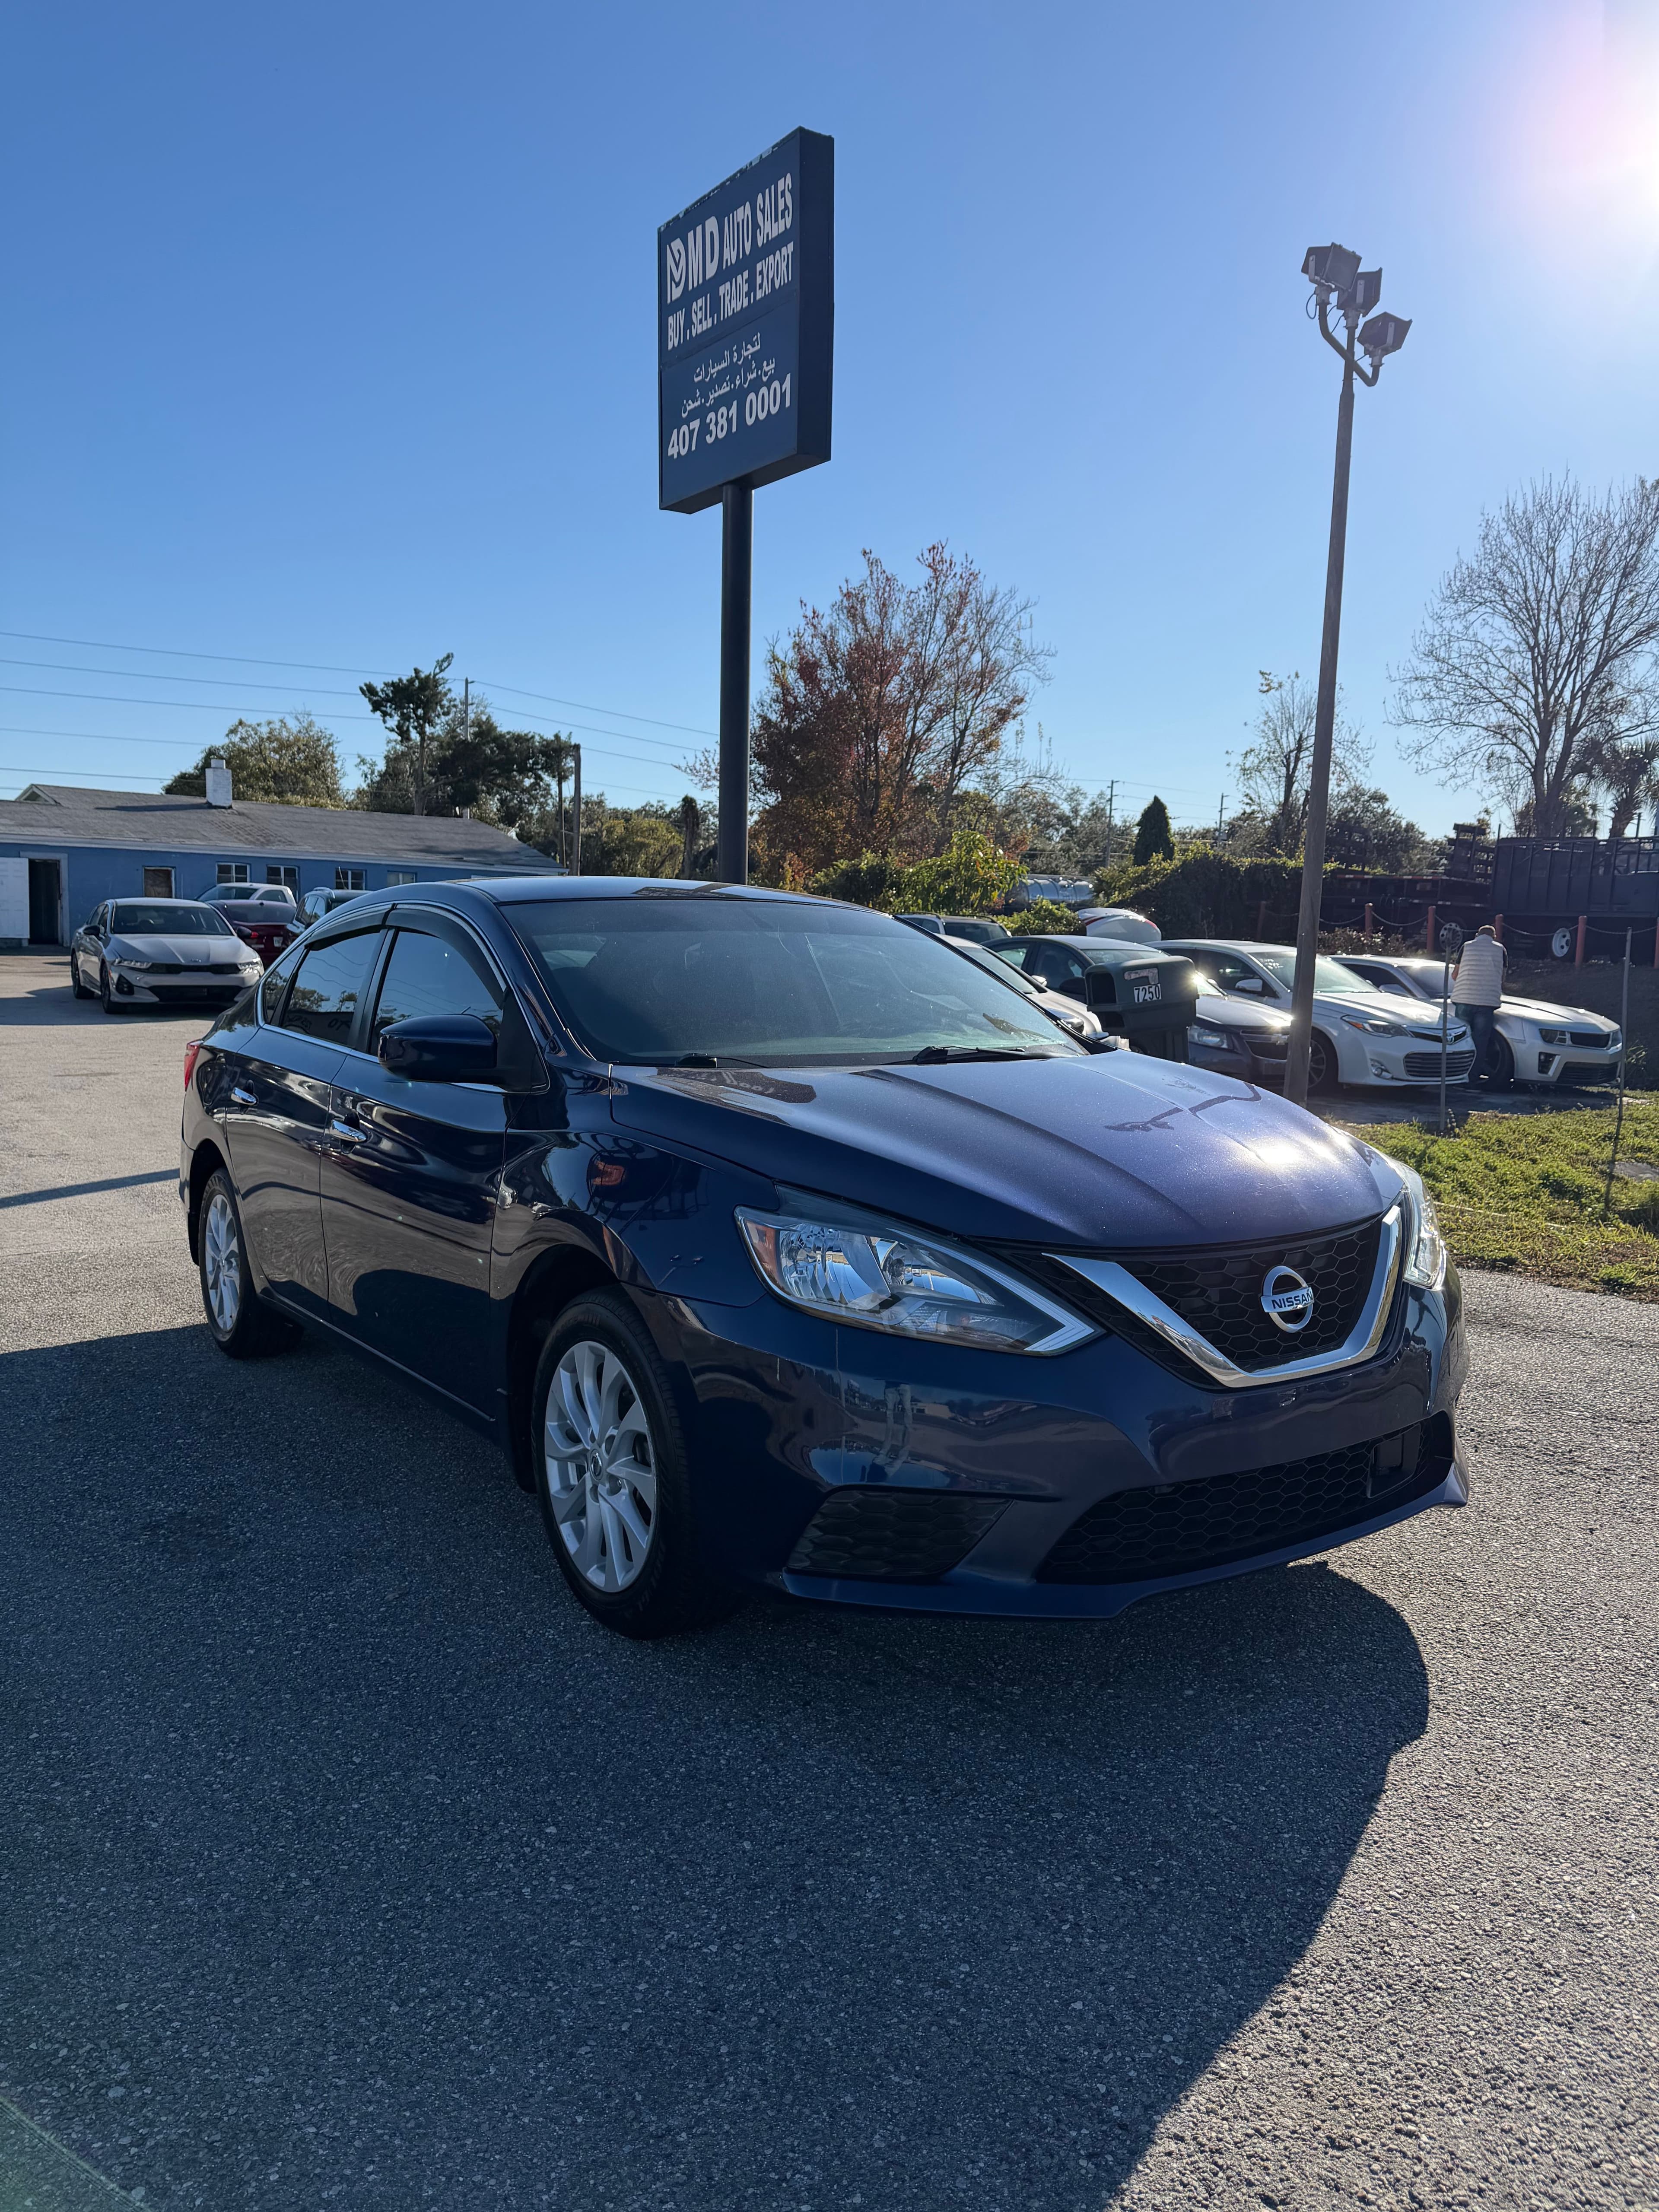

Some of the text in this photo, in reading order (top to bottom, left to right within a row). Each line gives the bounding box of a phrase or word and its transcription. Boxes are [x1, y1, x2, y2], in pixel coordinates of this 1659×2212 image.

[688, 216, 719, 291] MD
[723, 201, 752, 270] AUTO
[756, 172, 792, 248] SALES
[756, 241, 794, 301] EXPORT
[694, 350, 730, 383] السيارات
[668, 373, 791, 459] 407 381 0001
[1135, 985, 1160, 1002] 7250
[1271, 1291, 1313, 1309] NISSAN
